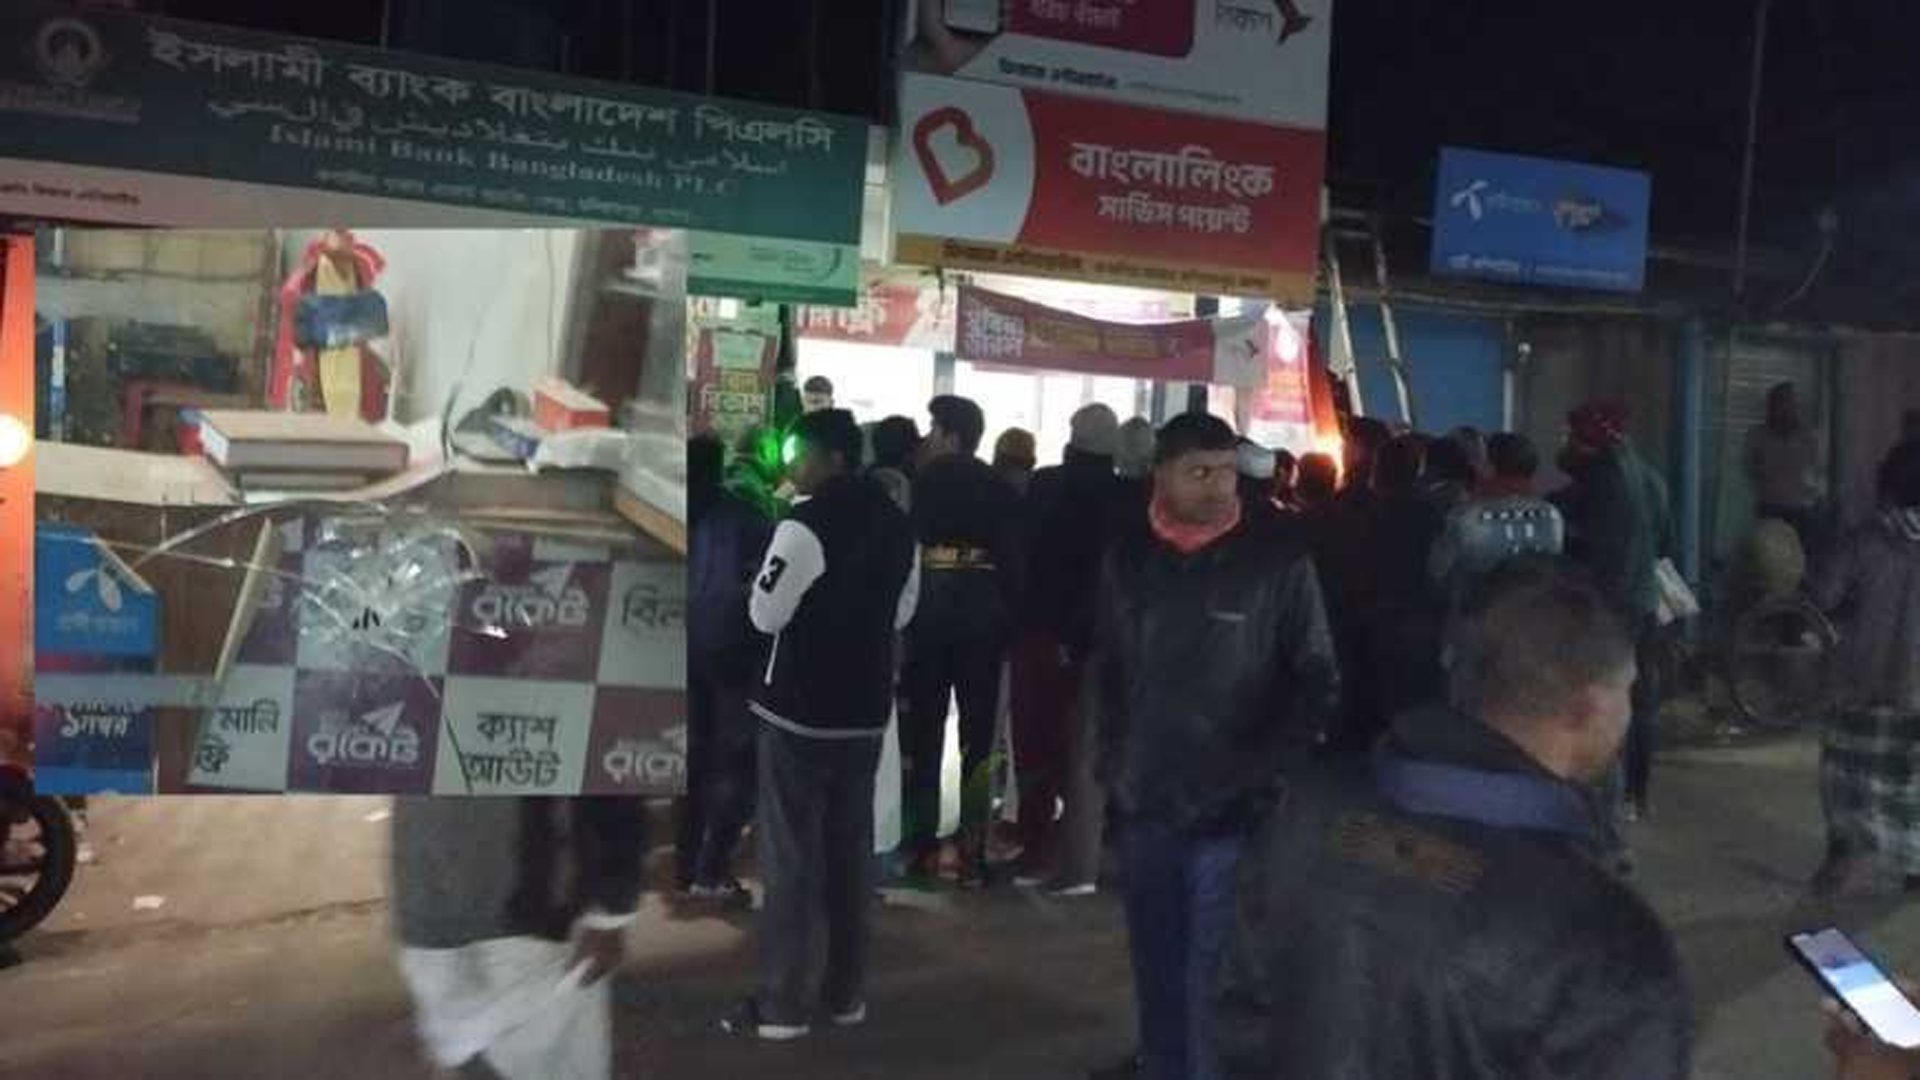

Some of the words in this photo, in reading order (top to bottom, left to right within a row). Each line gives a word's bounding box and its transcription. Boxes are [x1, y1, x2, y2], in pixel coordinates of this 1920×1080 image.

[147, 27, 324, 88] ইসলামী
[348, 64, 476, 105] ব্যাংক
[490, 83, 677, 134] বাংলাদেশ
[693, 104, 836, 155] পিএলসি
[269, 122, 377, 154] Islami
[391, 139, 476, 168] Bank
[488, 150, 663, 188] Bangladesh
[1069, 141, 1276, 199] বাংলালিংক
[1097, 193, 1176, 227] সার্ভিস
[476, 711, 558, 747] ক্যাশ
